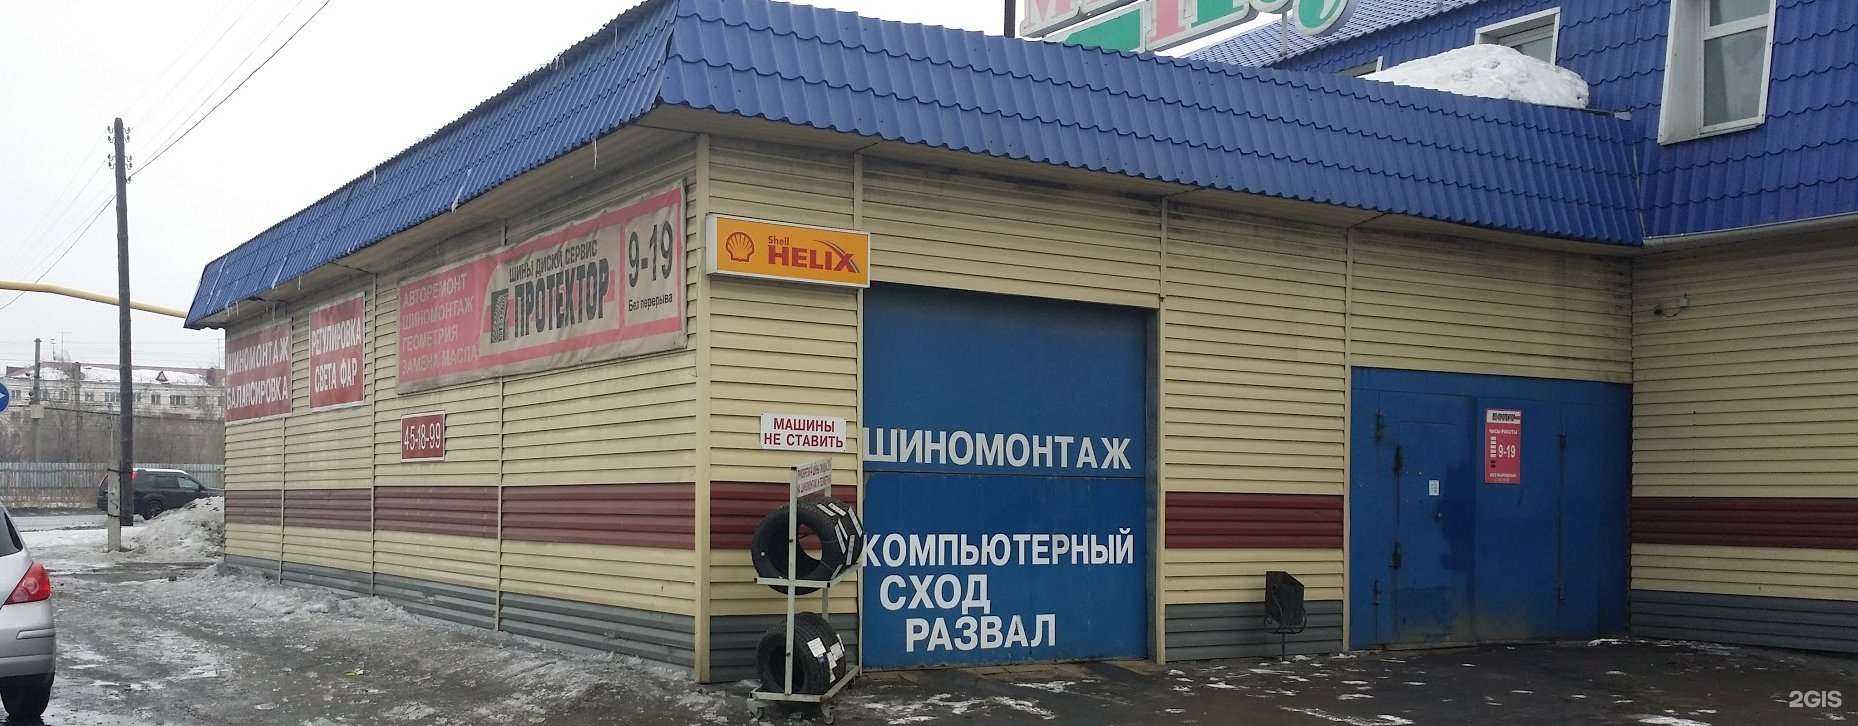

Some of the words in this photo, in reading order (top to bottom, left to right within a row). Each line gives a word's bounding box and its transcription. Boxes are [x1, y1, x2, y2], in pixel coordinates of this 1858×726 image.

[628, 220, 673, 288] 9-19
[767, 235, 790, 246] Shell
[767, 242, 860, 274] HELIX
[509, 261, 534, 283] ШИНЫ
[535, 249, 563, 279] ДИСКИ
[564, 239, 598, 266] СЕРВИС
[402, 273, 468, 308] АВТОРЕМОНТ
[514, 258, 610, 338] ПРОТЕКТОР
[640, 292, 673, 311] перерыва
[402, 296, 474, 331] ШИНОМОНТАЖ
[311, 317, 362, 356] РЕГУЛИРОВКА
[402, 324, 459, 353] ГЕОМЕТРИЯ
[227, 336, 289, 376] ШИНОМОНТАЖ
[441, 343, 480, 369] МАСЛА
[314, 362, 337, 393] СВЕТА
[340, 357, 359, 389] ФАР
[226, 376, 289, 410] БАЛАНСИРОВКА
[404, 422, 441, 450] 45-18-99
[764, 432, 781, 446] НЕ
[786, 433, 844, 448] СТАВИТЬ
[773, 417, 835, 433] МАШИНЫ
[863, 427, 1132, 469] ШИНОМОНТАЖ
[1498, 443, 1516, 458] 9-19
[862, 527, 1134, 567] КОМПЬЮТЕРНЫЙ
[879, 573, 991, 615] СХОД
[906, 613, 1056, 653] РАЗВАЛ
